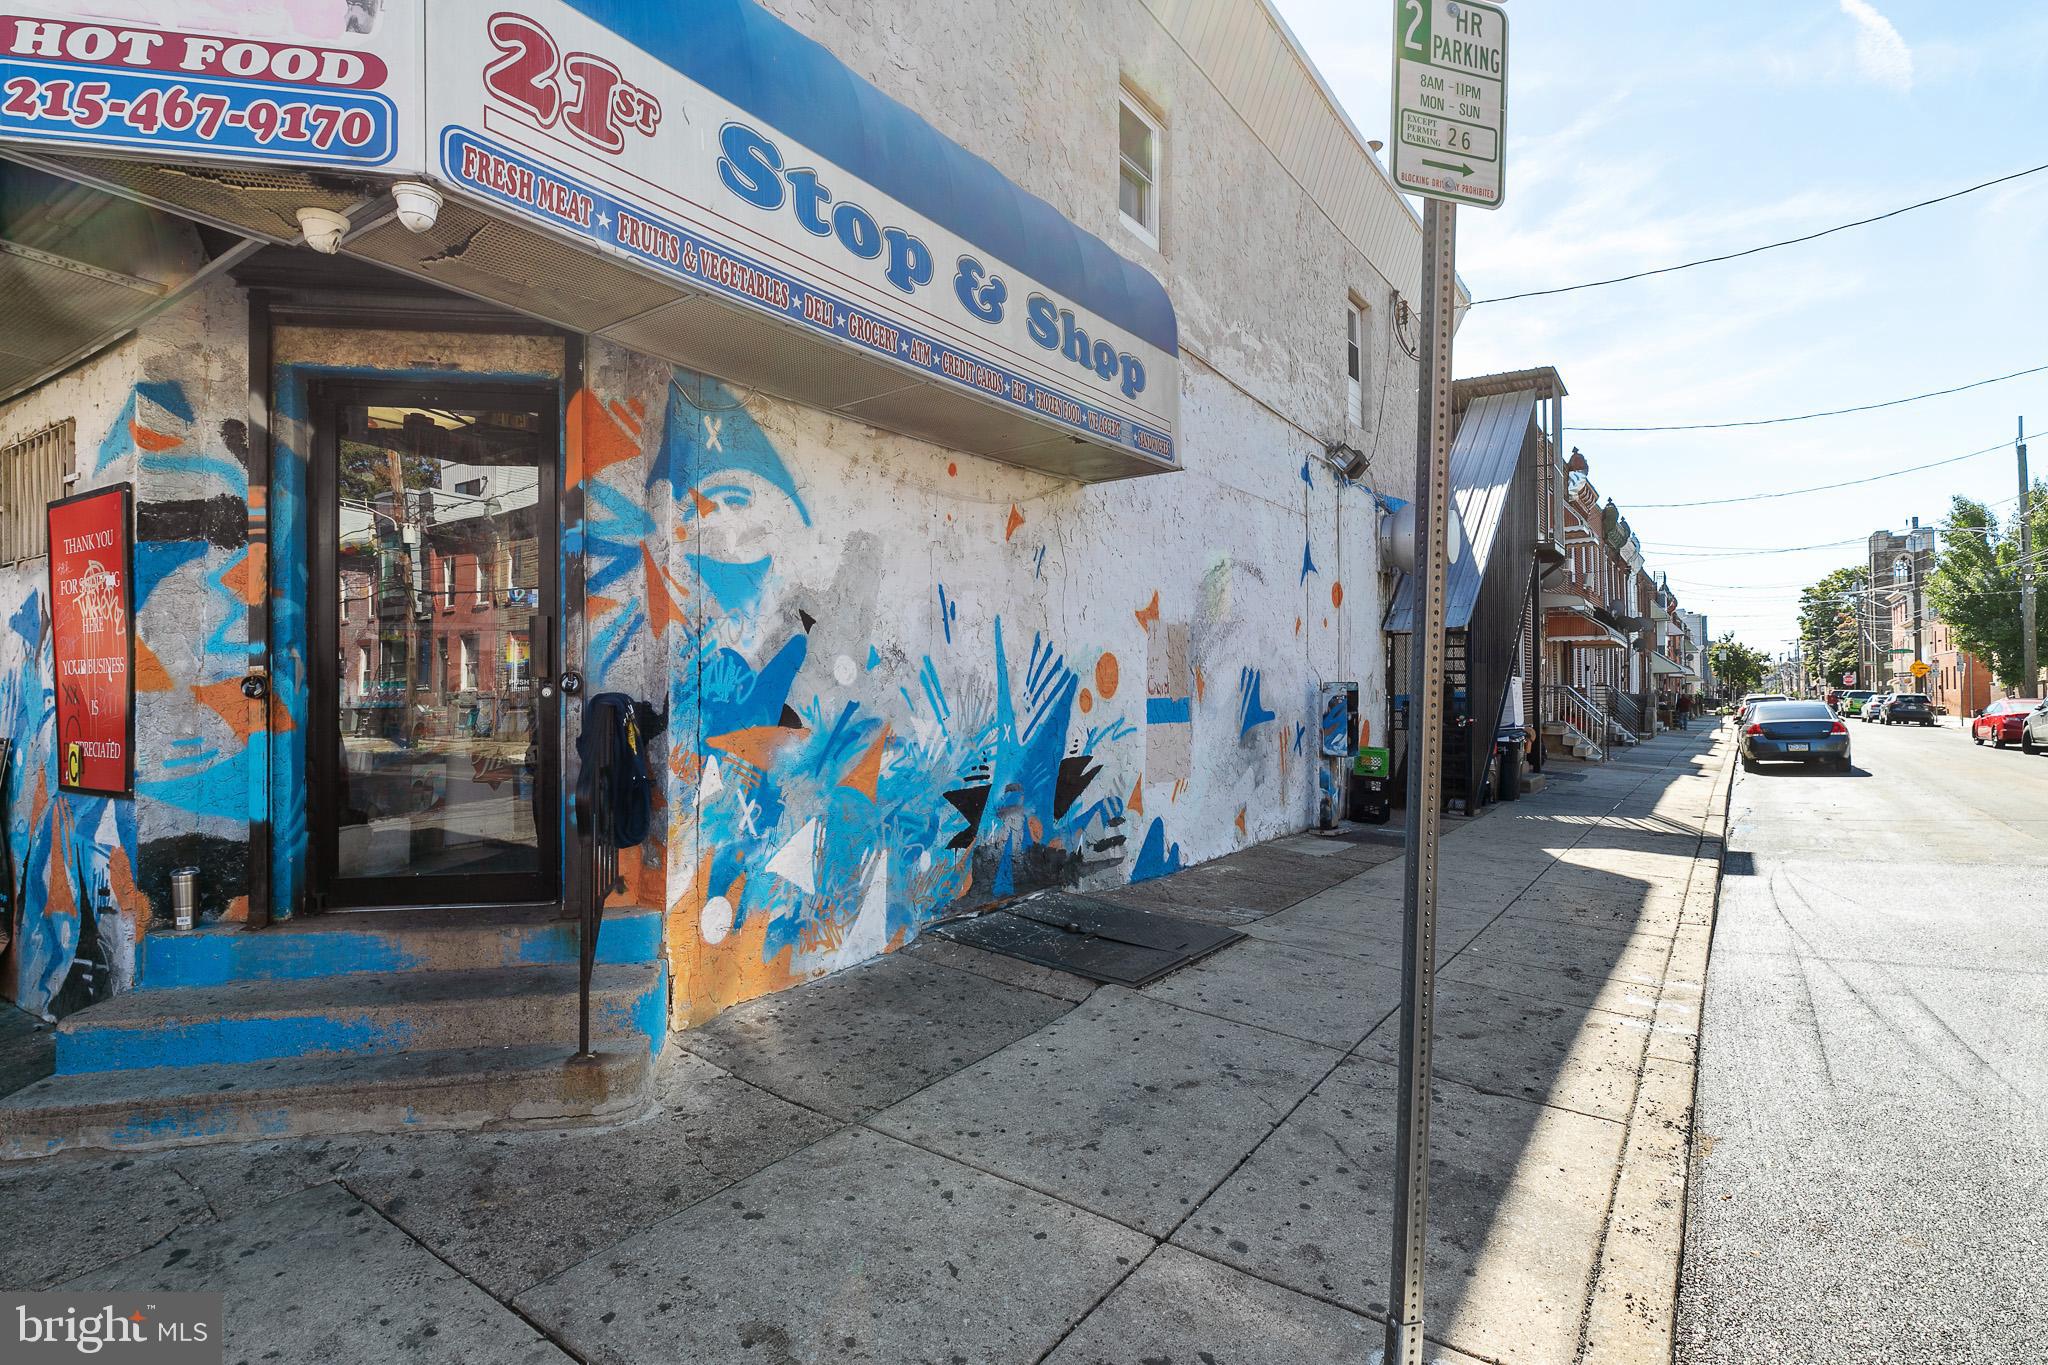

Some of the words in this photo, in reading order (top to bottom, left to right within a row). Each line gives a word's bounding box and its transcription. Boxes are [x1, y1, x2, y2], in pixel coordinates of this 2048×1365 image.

[1404, 0, 1423, 51] 2
[1456, 10, 1482, 38] HR
[10, 20, 164, 66] HOT
[180, 37, 365, 86] FOOD
[1433, 34, 1500, 74] PARKING
[1420, 73, 1444, 91] 8AM
[3, 77, 376, 149] 215-467-9170
[1420, 93, 1445, 111] MON
[1459, 102, 1480, 119] SUN
[1407, 114, 1438, 127] EXCEPT
[1407, 123, 1439, 137] PERMIT
[1407, 132, 1441, 147] PARKING
[1401, 172, 1430, 186] BLOCKING
[1461, 184, 1495, 199] PROHIBITED
[717, 121, 934, 294] Stop
[953, 253, 1009, 325] &
[1026, 291, 1147, 400] Shop
[462, 145, 534, 204] FRESH
[538, 176, 593, 228] MEAT
[617, 212, 680, 265] FRUITS
[683, 240, 698, 272] &
[699, 248, 790, 310] VEGETABLES
[804, 293, 834, 329] DELI
[848, 312, 898, 354] GROCERY
[910, 337, 932, 367] ATM
[941, 351, 975, 383] CREDIT
[975, 365, 1005, 394] CARDS
[1011, 379, 1027, 404] EBT
[1034, 388, 1062, 417] FROZEN
[1063, 401, 1082, 424] FOOD
[1088, 409, 1098, 431] WE
[1099, 414, 1121, 438] ACCEPT
[1138, 430, 1170, 458] SANDWICHES
[64, 533, 95, 555] THANK
[95, 528, 114, 548] YOU
[60, 579, 79, 596] FOR
[82, 617, 105, 634] HERE
[62, 659, 87, 676] YOUR
[88, 656, 125, 675] BUSINESS
[91, 698, 99, 716] IS
